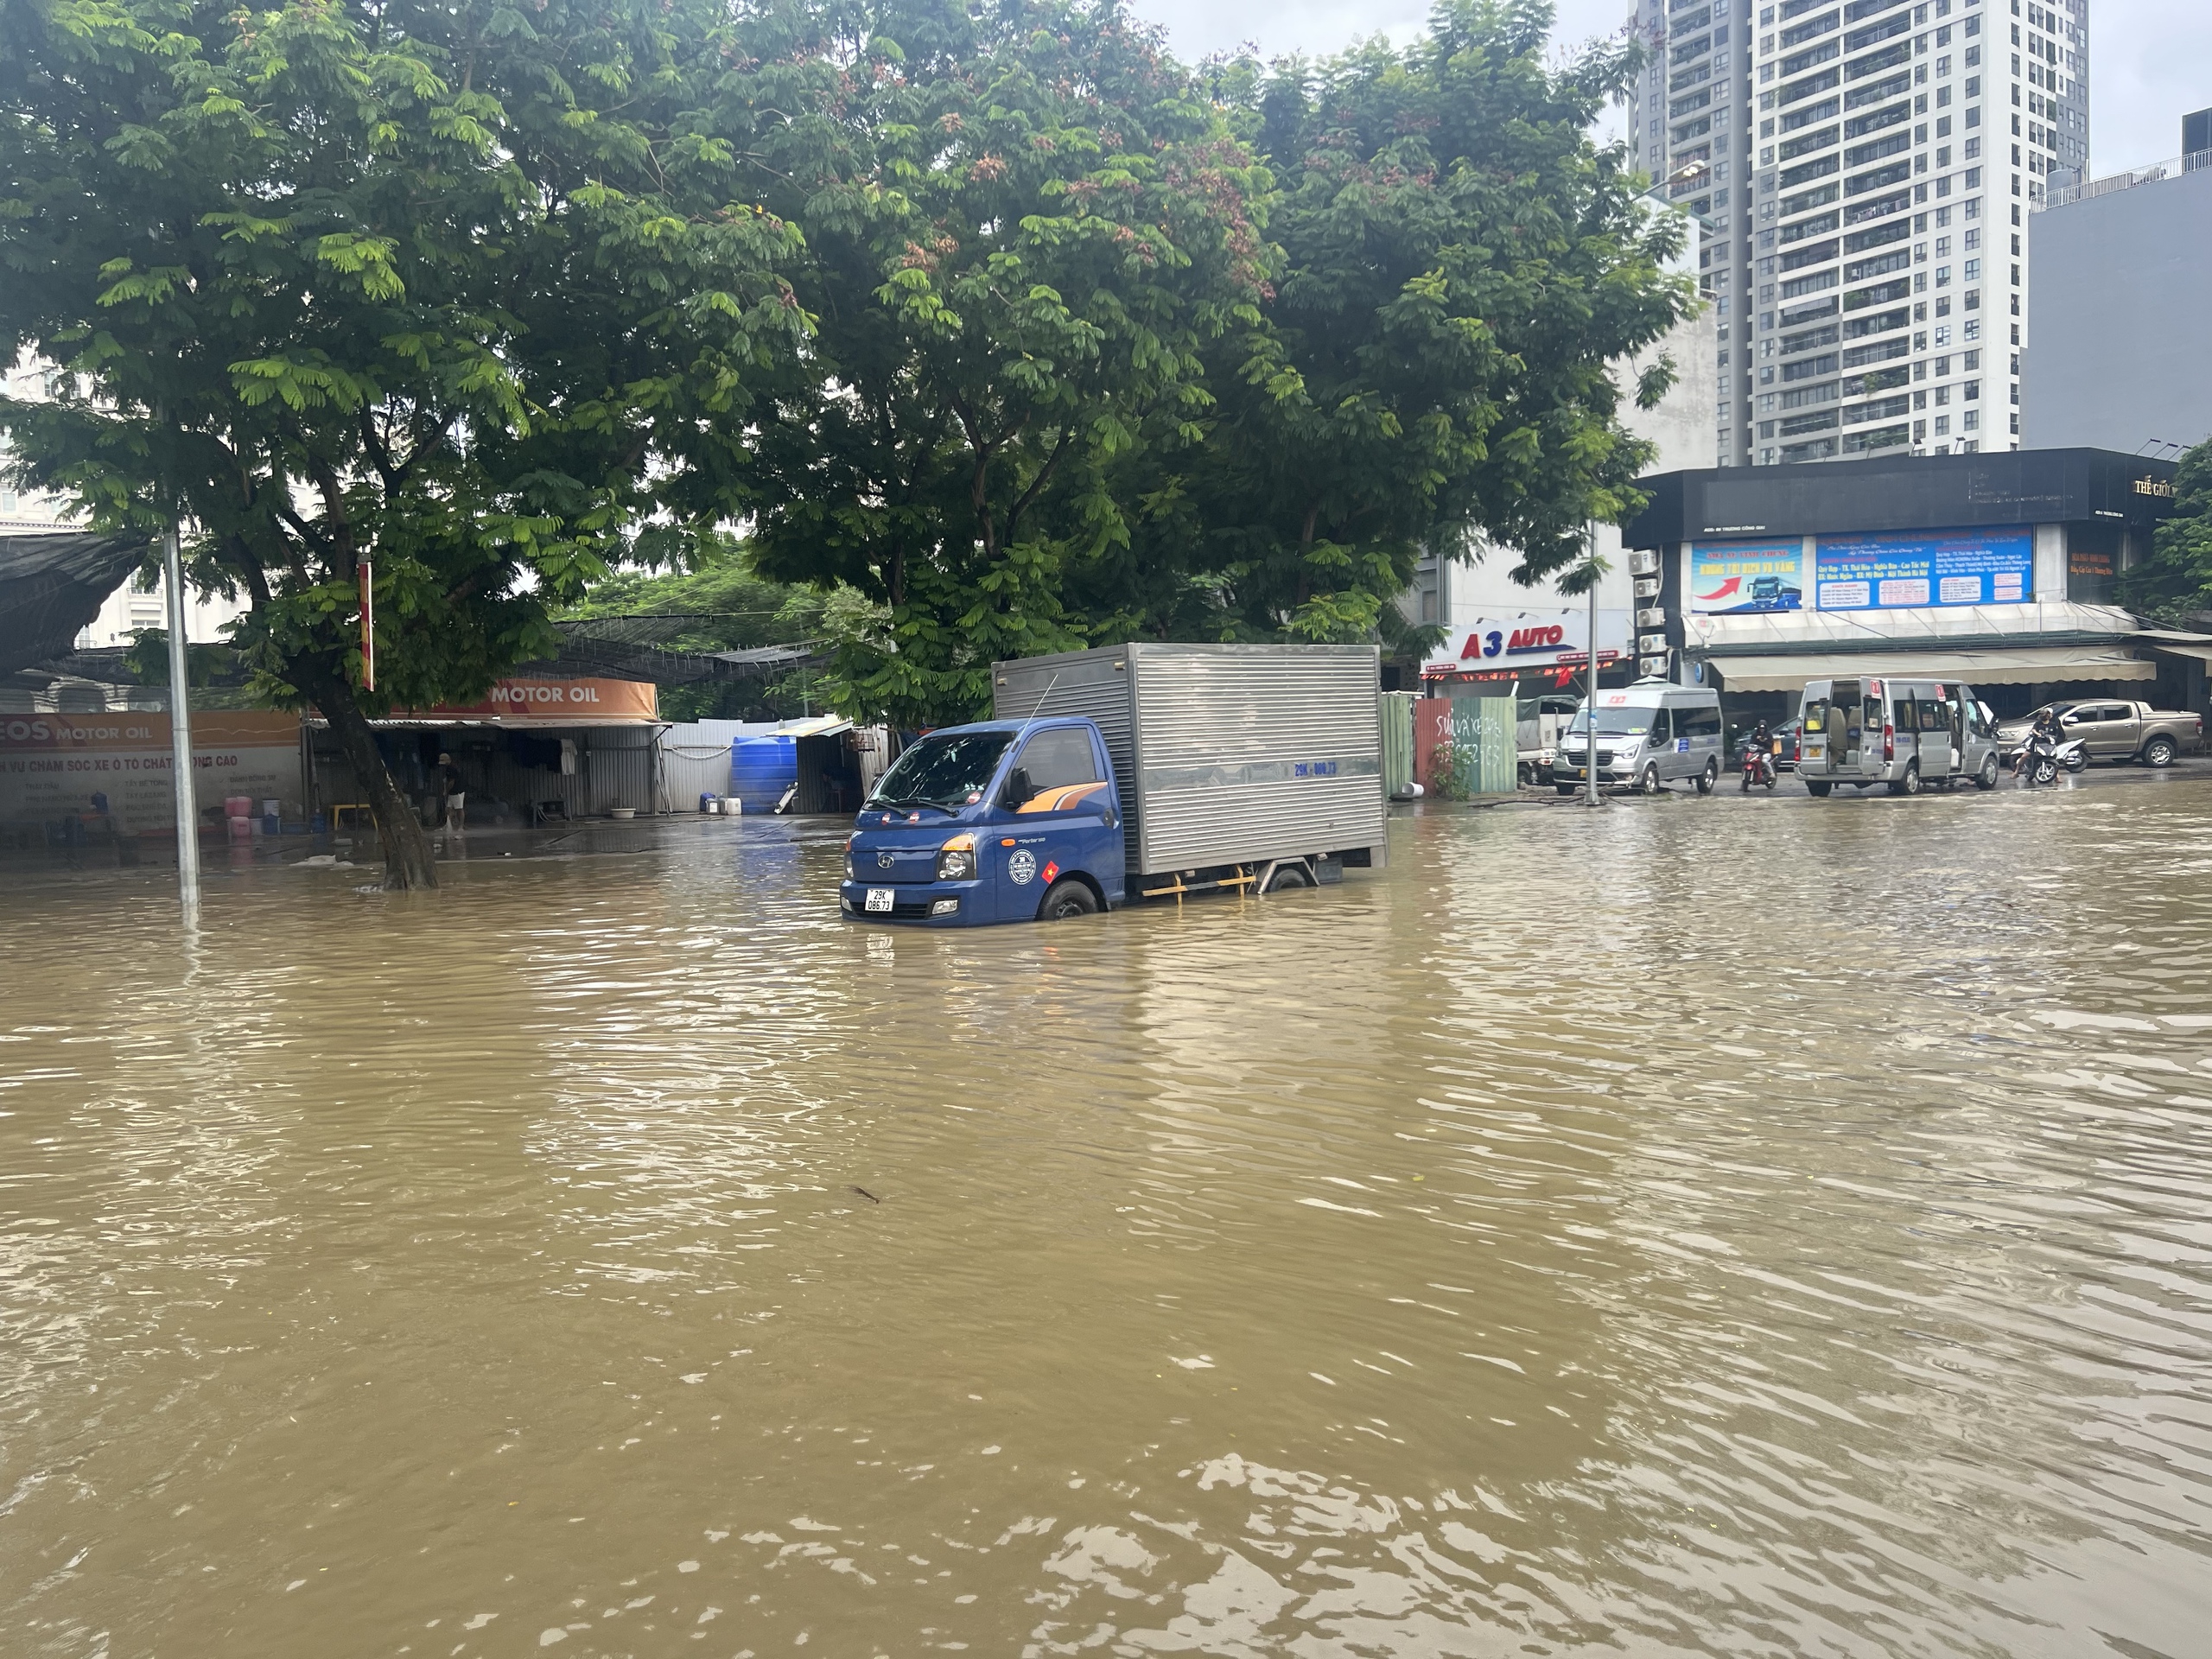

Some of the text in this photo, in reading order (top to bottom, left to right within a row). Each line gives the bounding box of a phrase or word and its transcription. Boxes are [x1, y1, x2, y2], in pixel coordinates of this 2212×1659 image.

[2135, 474, 2152, 495] THẾ
[1507, 625, 1563, 648] AUTO
[491, 687, 600, 702] MOTOR OIL
[56, 728, 119, 741] MOTOR
[125, 727, 153, 741] OIL
[95, 760, 110, 771] XE
[216, 755, 238, 767] CAO
[874, 890, 887, 899] 29K
[868, 900, 890, 910] 086.73
